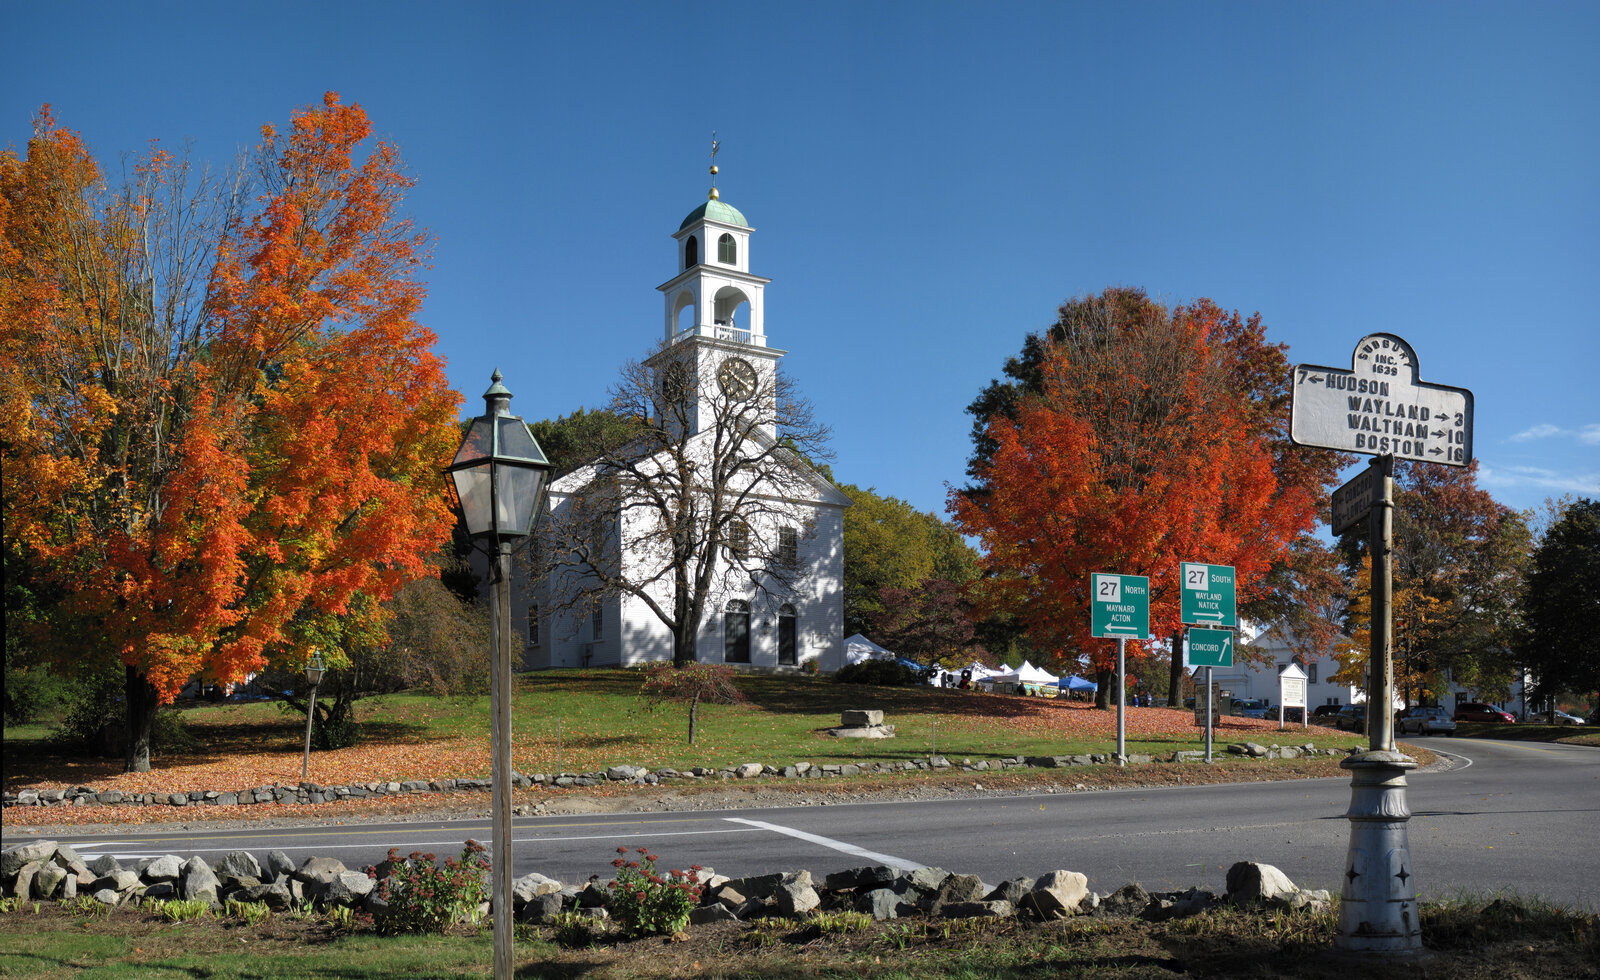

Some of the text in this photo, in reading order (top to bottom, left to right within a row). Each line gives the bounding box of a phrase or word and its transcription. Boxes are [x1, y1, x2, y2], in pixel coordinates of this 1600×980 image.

[1358, 339, 1413, 367] SUDBURY
[1375, 353, 1397, 366] INC.
[1297, 370, 1389, 397] 7 HUDSON
[1347, 396, 1464, 427] WAYLAND 3
[1347, 413, 1464, 445] WALTHAM 10
[1355, 432, 1425, 457] BOSTON
[1188, 570, 1232, 584] 27 SOUTH
[1100, 581, 1145, 596] 27 NORTH
[1195, 592, 1222, 601] WAYLAND
[1106, 604, 1135, 613] MAYNARD
[1198, 601, 1219, 610] NATICK
[1111, 614, 1131, 622] ACTON
[1191, 643, 1219, 652] CONCORD
